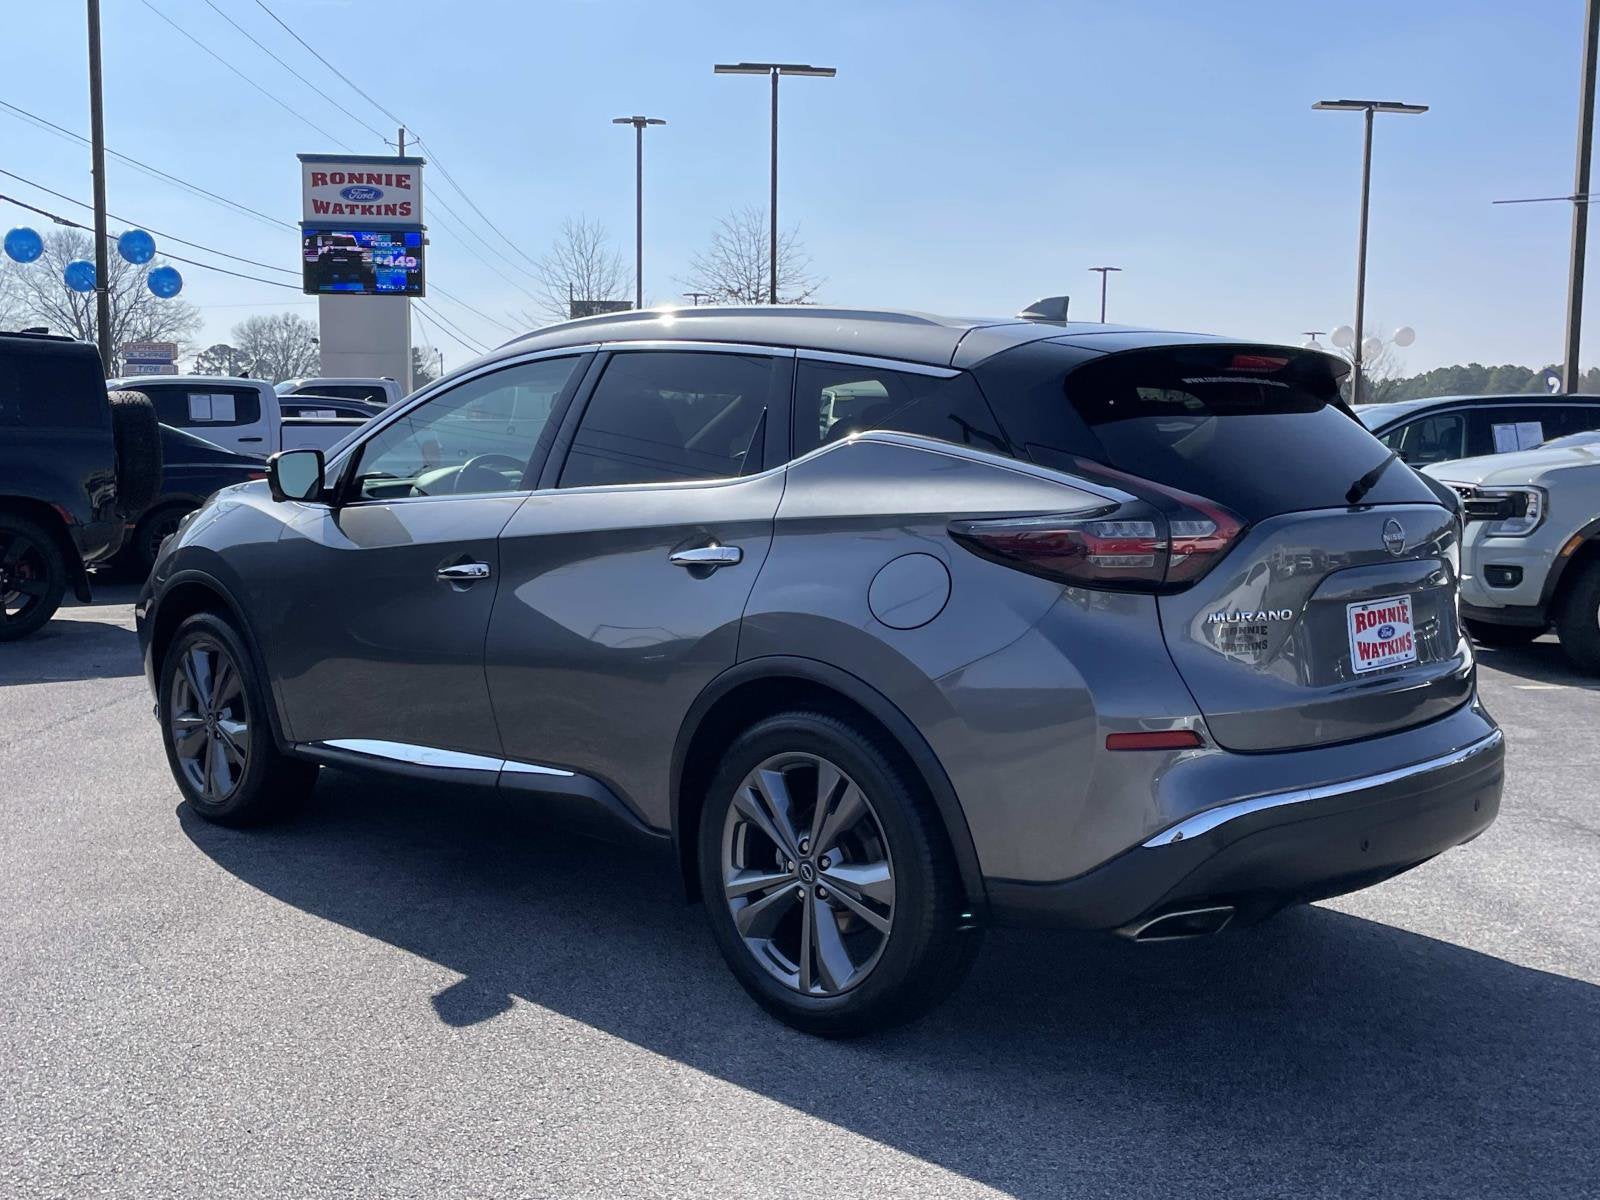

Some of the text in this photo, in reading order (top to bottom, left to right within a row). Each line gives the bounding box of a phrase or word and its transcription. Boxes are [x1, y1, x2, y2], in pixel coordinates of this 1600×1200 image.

[311, 172, 411, 190] RONNIE
[348, 188, 376, 200] Ford
[312, 199, 412, 217] WATKINS
[137, 365, 161, 373] TIRE
[1207, 609, 1293, 624] MURANO
[1354, 604, 1410, 634] RONNIE
[1357, 631, 1412, 661] WATKINS
